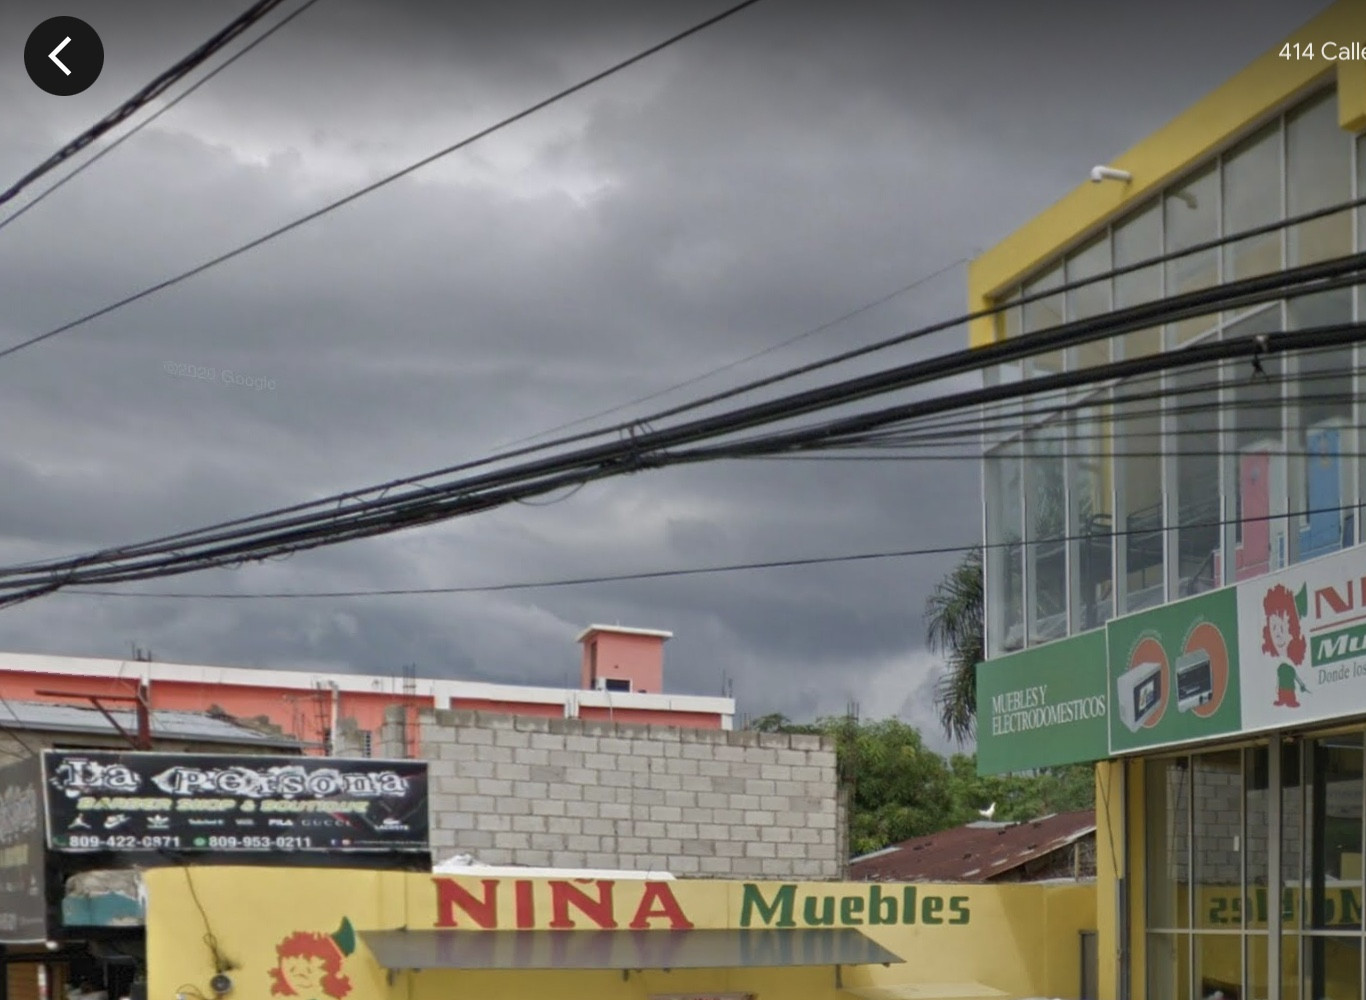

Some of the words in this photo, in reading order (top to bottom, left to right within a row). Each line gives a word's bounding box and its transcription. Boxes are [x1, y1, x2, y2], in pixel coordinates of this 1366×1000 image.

[1318, 667, 1350, 685] Donde
[992, 686, 1038, 713] MUEBLES
[1039, 684, 1047, 705] Y
[992, 695, 1105, 736] ELECTRODOMESTICOS
[209, 837, 311, 848] 809-953-0211
[432, 878, 695, 929] NIÑA
[740, 884, 971, 927] Muebles
